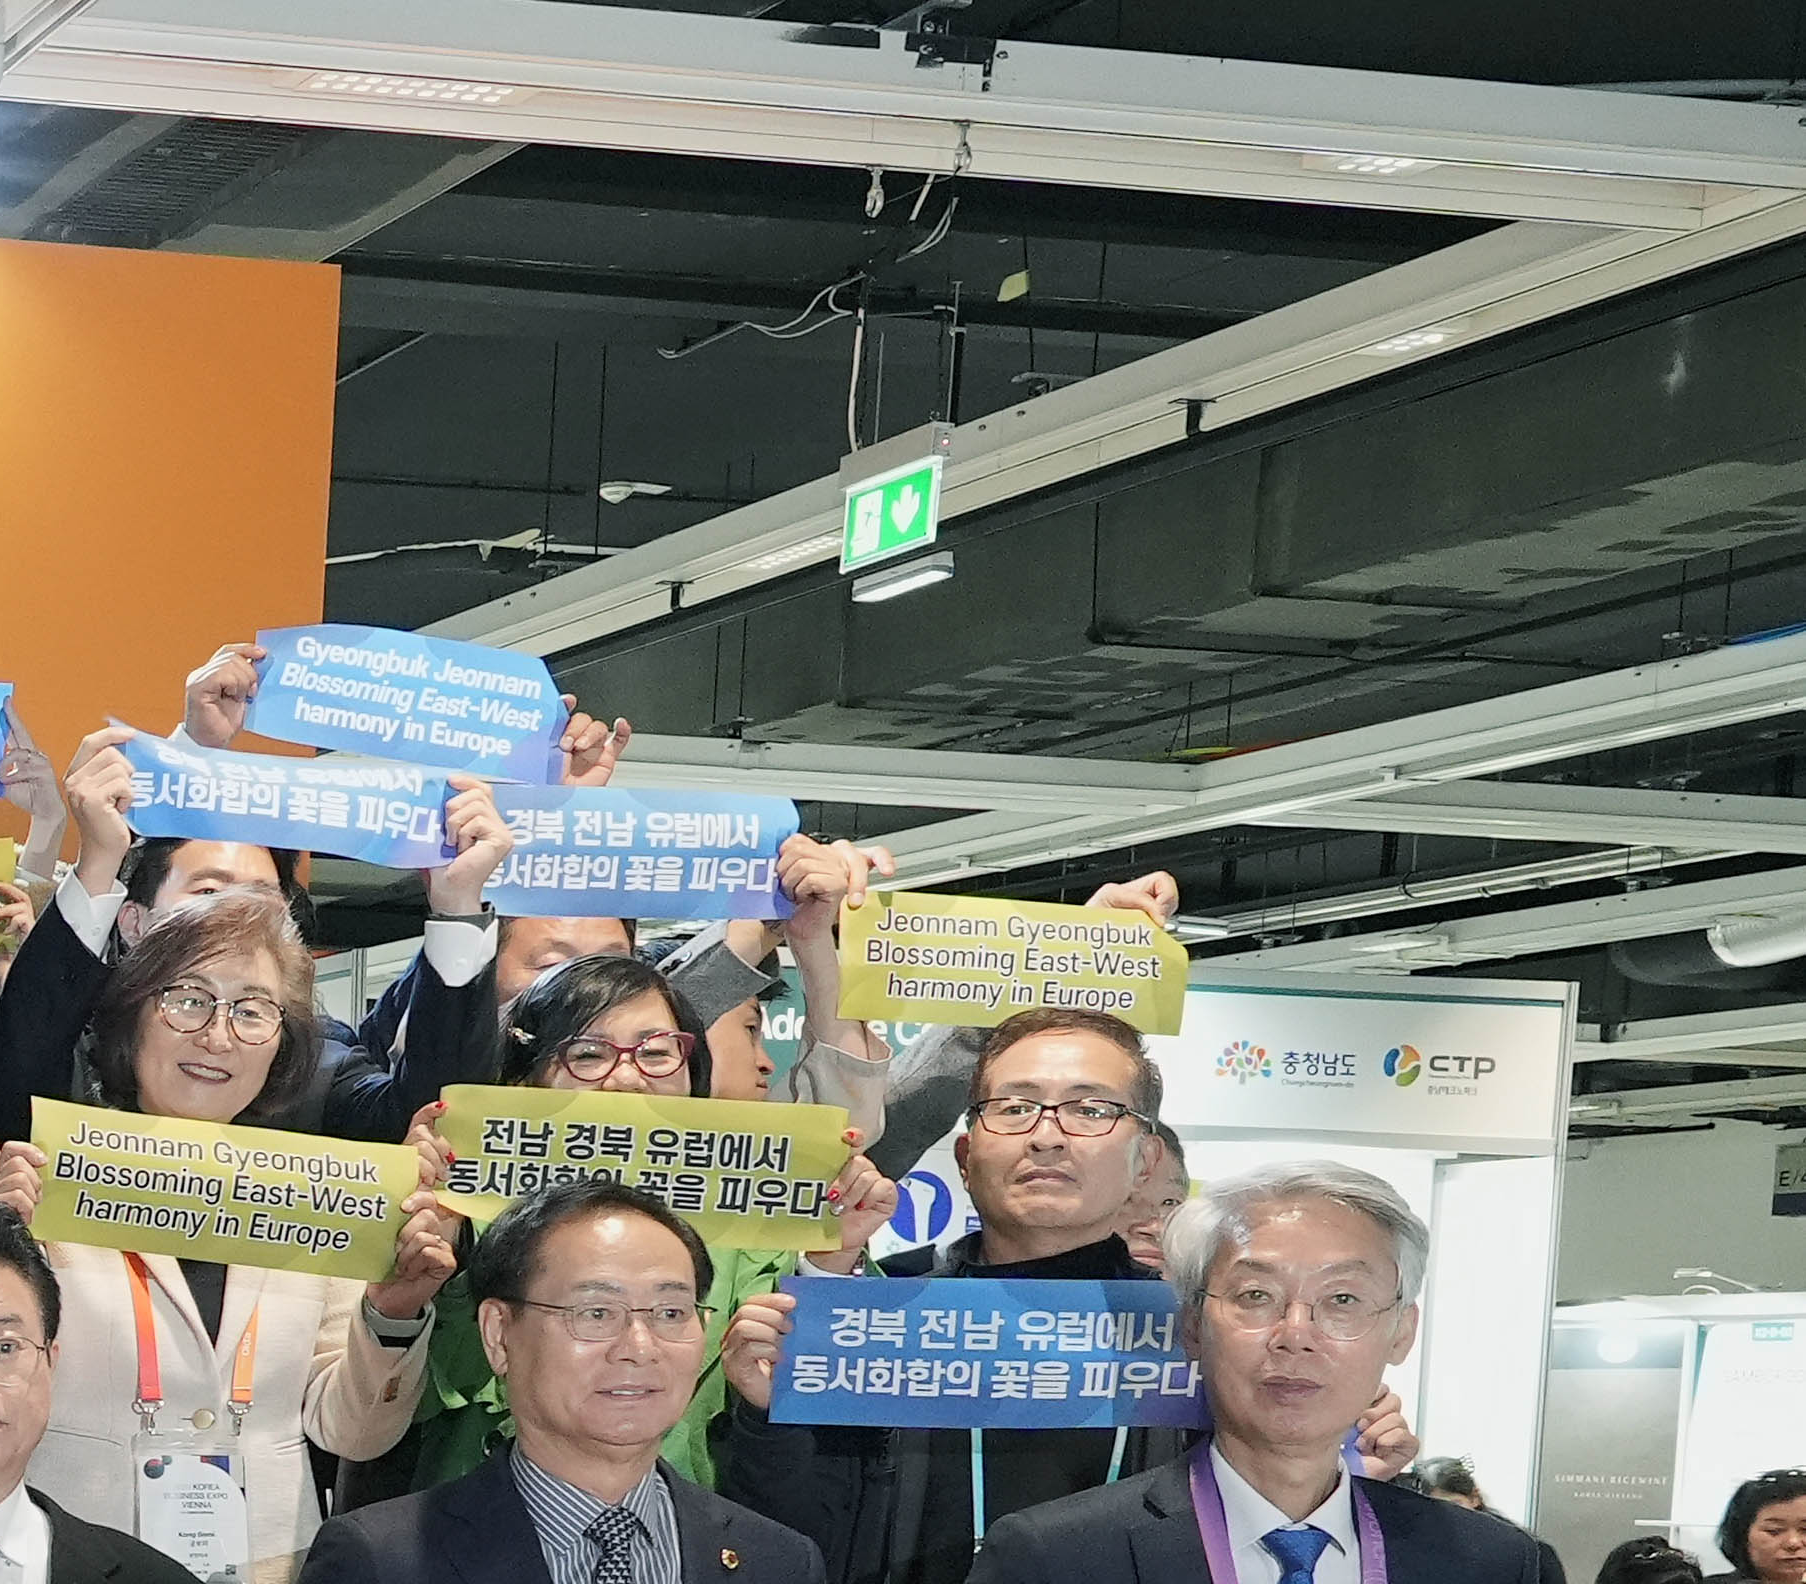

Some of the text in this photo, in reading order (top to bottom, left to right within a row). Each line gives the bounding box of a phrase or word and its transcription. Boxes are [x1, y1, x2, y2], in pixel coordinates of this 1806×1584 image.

[297, 636, 542, 699] Gyeongbuk Jeonnam
[280, 662, 543, 731] Blossoming East-West
[295, 697, 512, 758] harmony in Europe
[506, 808, 760, 849] 경북 전남 유럽에서
[625, 856, 777, 894] 꽃을 피우다
[876, 909, 1152, 949] Jeonnam Gyeongbuk
[866, 939, 1161, 978] Blossoming East-West
[888, 974, 1134, 1012] harmony in Europe
[1282, 1051, 1356, 1077] 충청남도
[1429, 1055, 1496, 1080] CTP
[70, 1122, 379, 1185] Jeonnam Gyeongbuk
[482, 1118, 789, 1172] 전남 경북 유럽에서
[55, 1151, 386, 1221] Blossoming East-West
[716, 1176, 829, 1219] 피우다
[75, 1191, 350, 1254] harmony in Europe
[830, 1307, 1174, 1352] 경북 전남 유럽에서
[791, 1356, 1203, 1401] 동서화합의 꽃을 피우다
